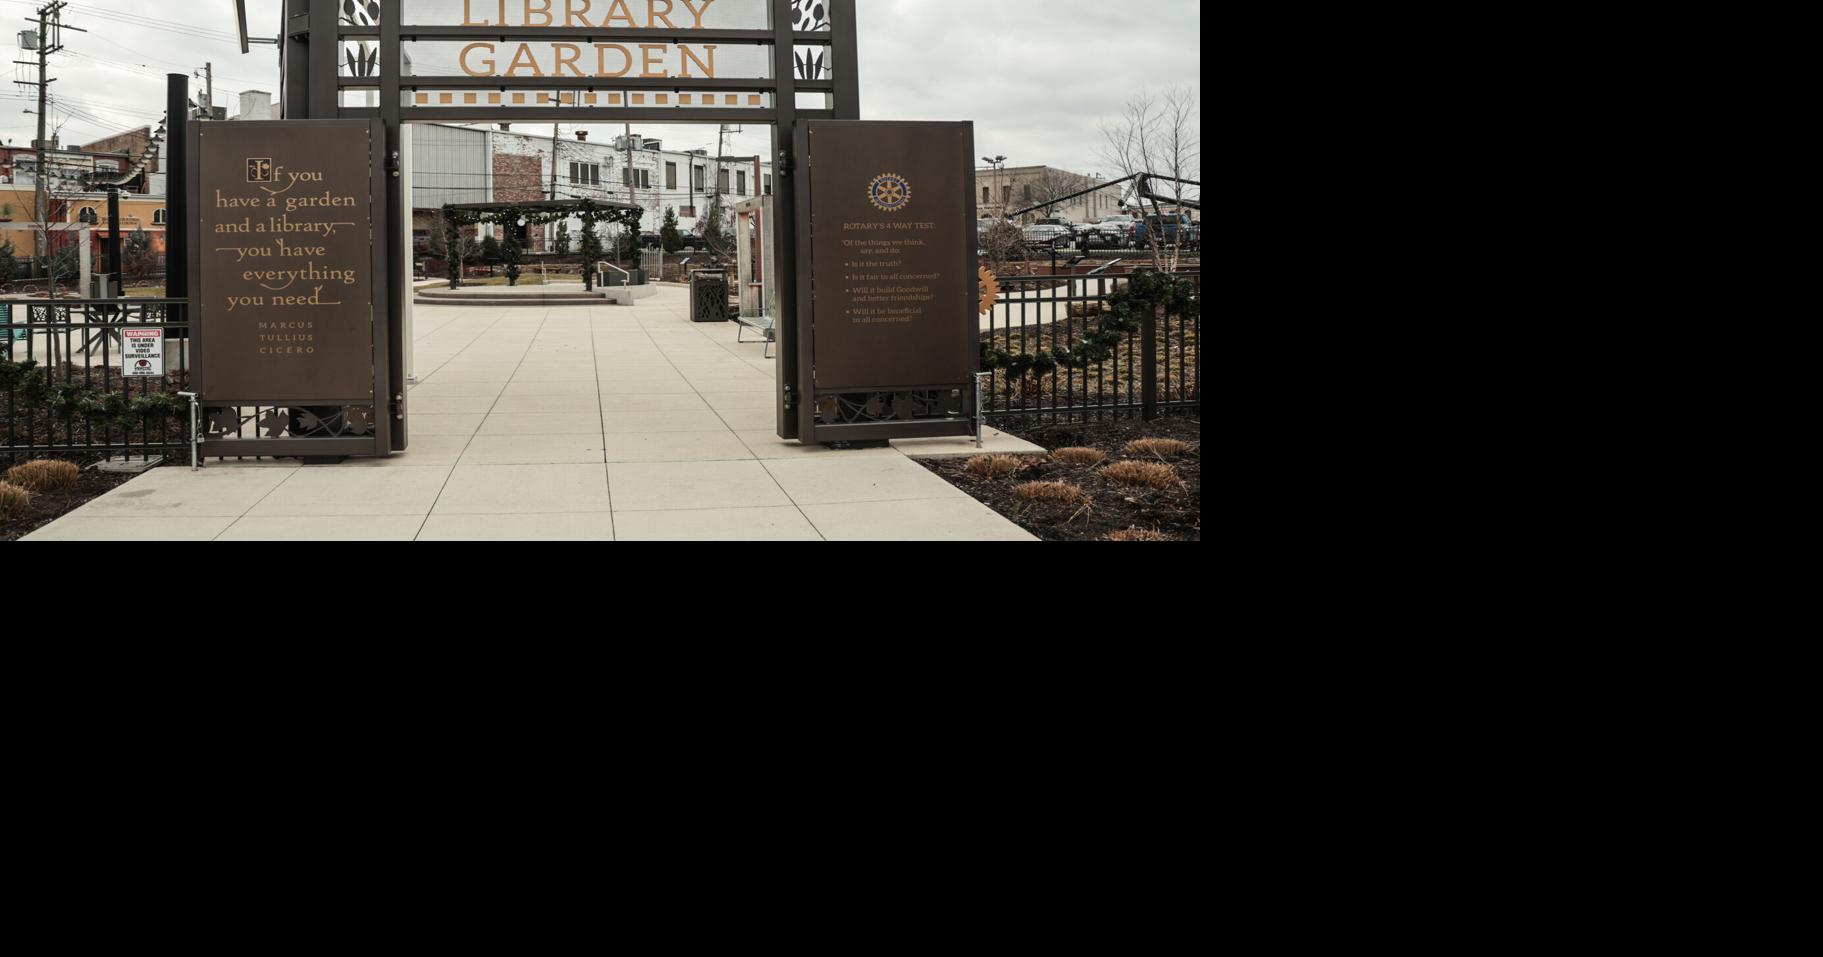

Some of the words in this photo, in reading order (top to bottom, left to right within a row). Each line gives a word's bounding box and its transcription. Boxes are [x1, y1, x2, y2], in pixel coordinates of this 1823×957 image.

[460, 0, 715, 29] LIBRARY
[459, 42, 717, 78] GARDEN
[247, 158, 284, 182] If
[260, 171, 323, 194] you
[215, 189, 260, 208] have
[266, 194, 277, 207] a
[285, 191, 356, 212] garden
[215, 217, 250, 233] and
[255, 223, 267, 233] a
[270, 214, 356, 237] library,
[843, 222, 885, 230] ROTARY'S
[892, 222, 912, 230] WAY
[216, 247, 272, 262] you
[275, 238, 326, 257] have
[868, 239, 891, 247] things
[243, 261, 356, 290] everything
[227, 295, 265, 312] you
[271, 284, 342, 306] need
[258, 321, 314, 329] MARCUS
[259, 334, 314, 342] TULLIUS
[259, 346, 315, 354] CICERO
